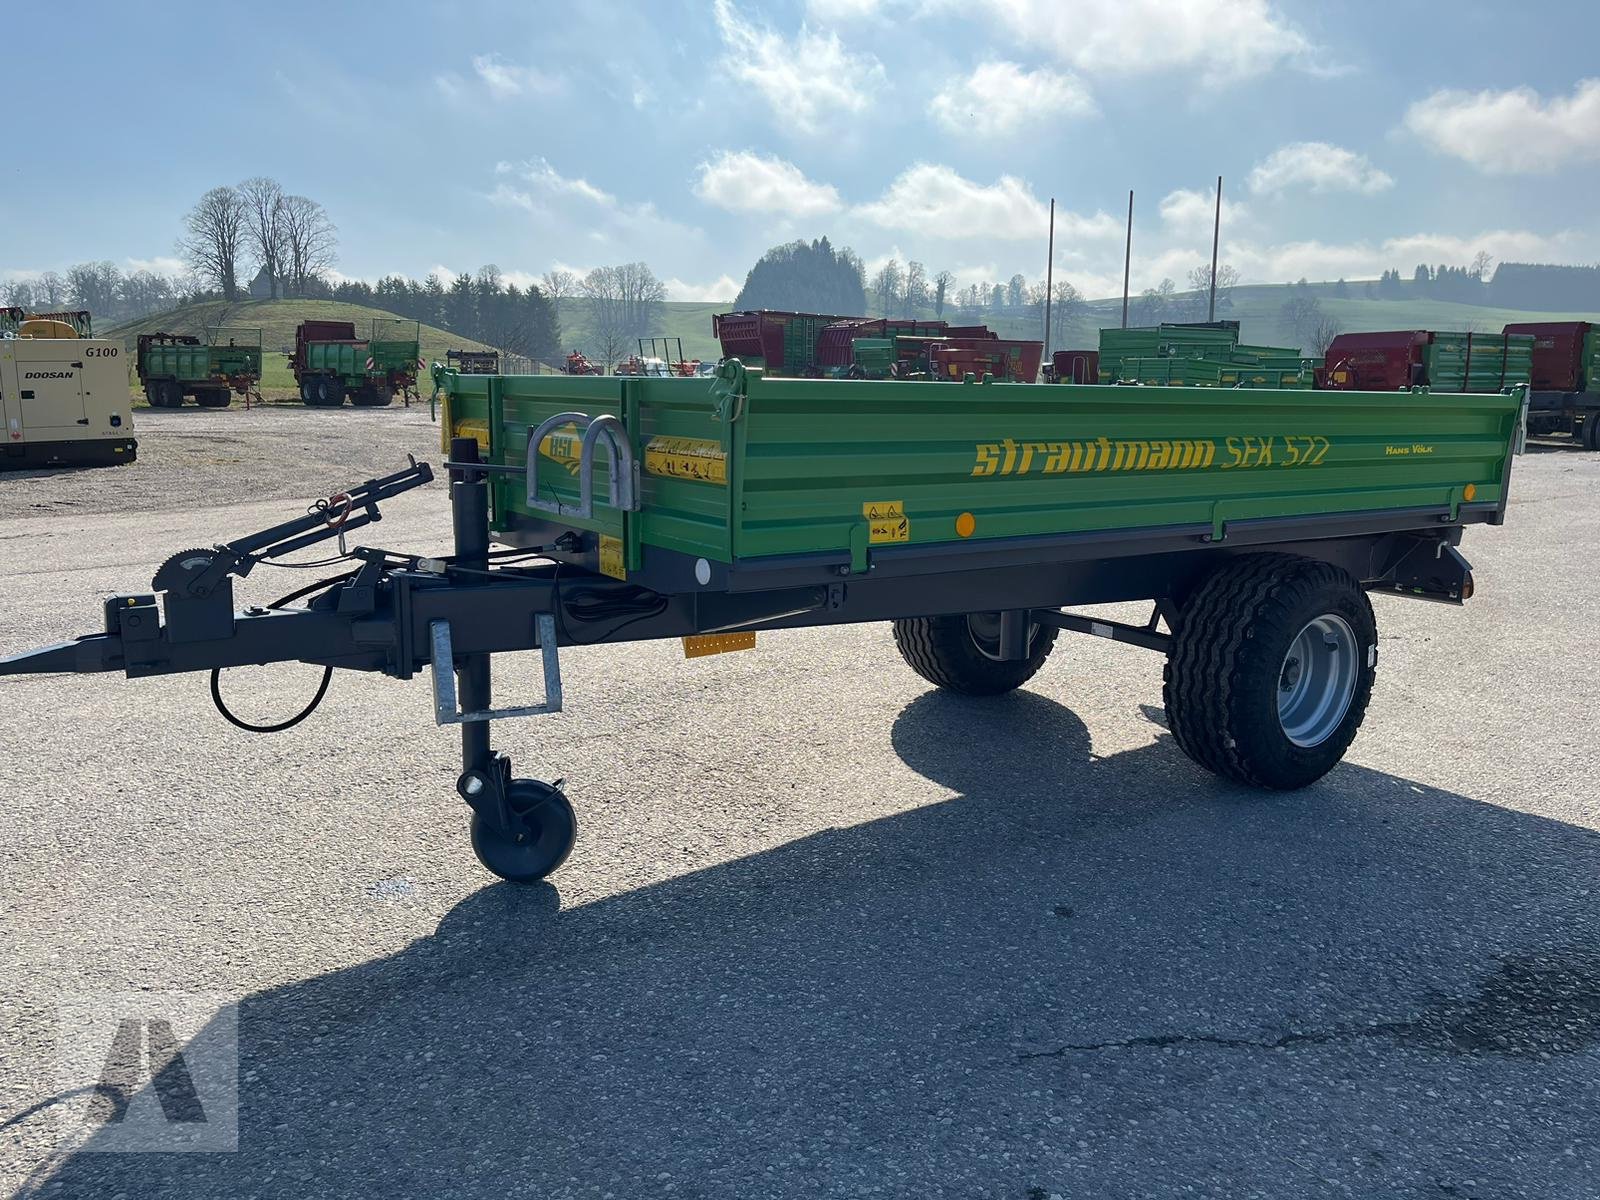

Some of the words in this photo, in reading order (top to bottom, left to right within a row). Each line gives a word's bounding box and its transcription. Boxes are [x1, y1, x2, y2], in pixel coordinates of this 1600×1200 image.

[85, 347, 118, 358] G100
[24, 371, 74, 379] DOOSAN
[1385, 445, 1410, 455] HANS
[970, 436, 1216, 476] strautmann
[1280, 436, 1330, 466] 572
